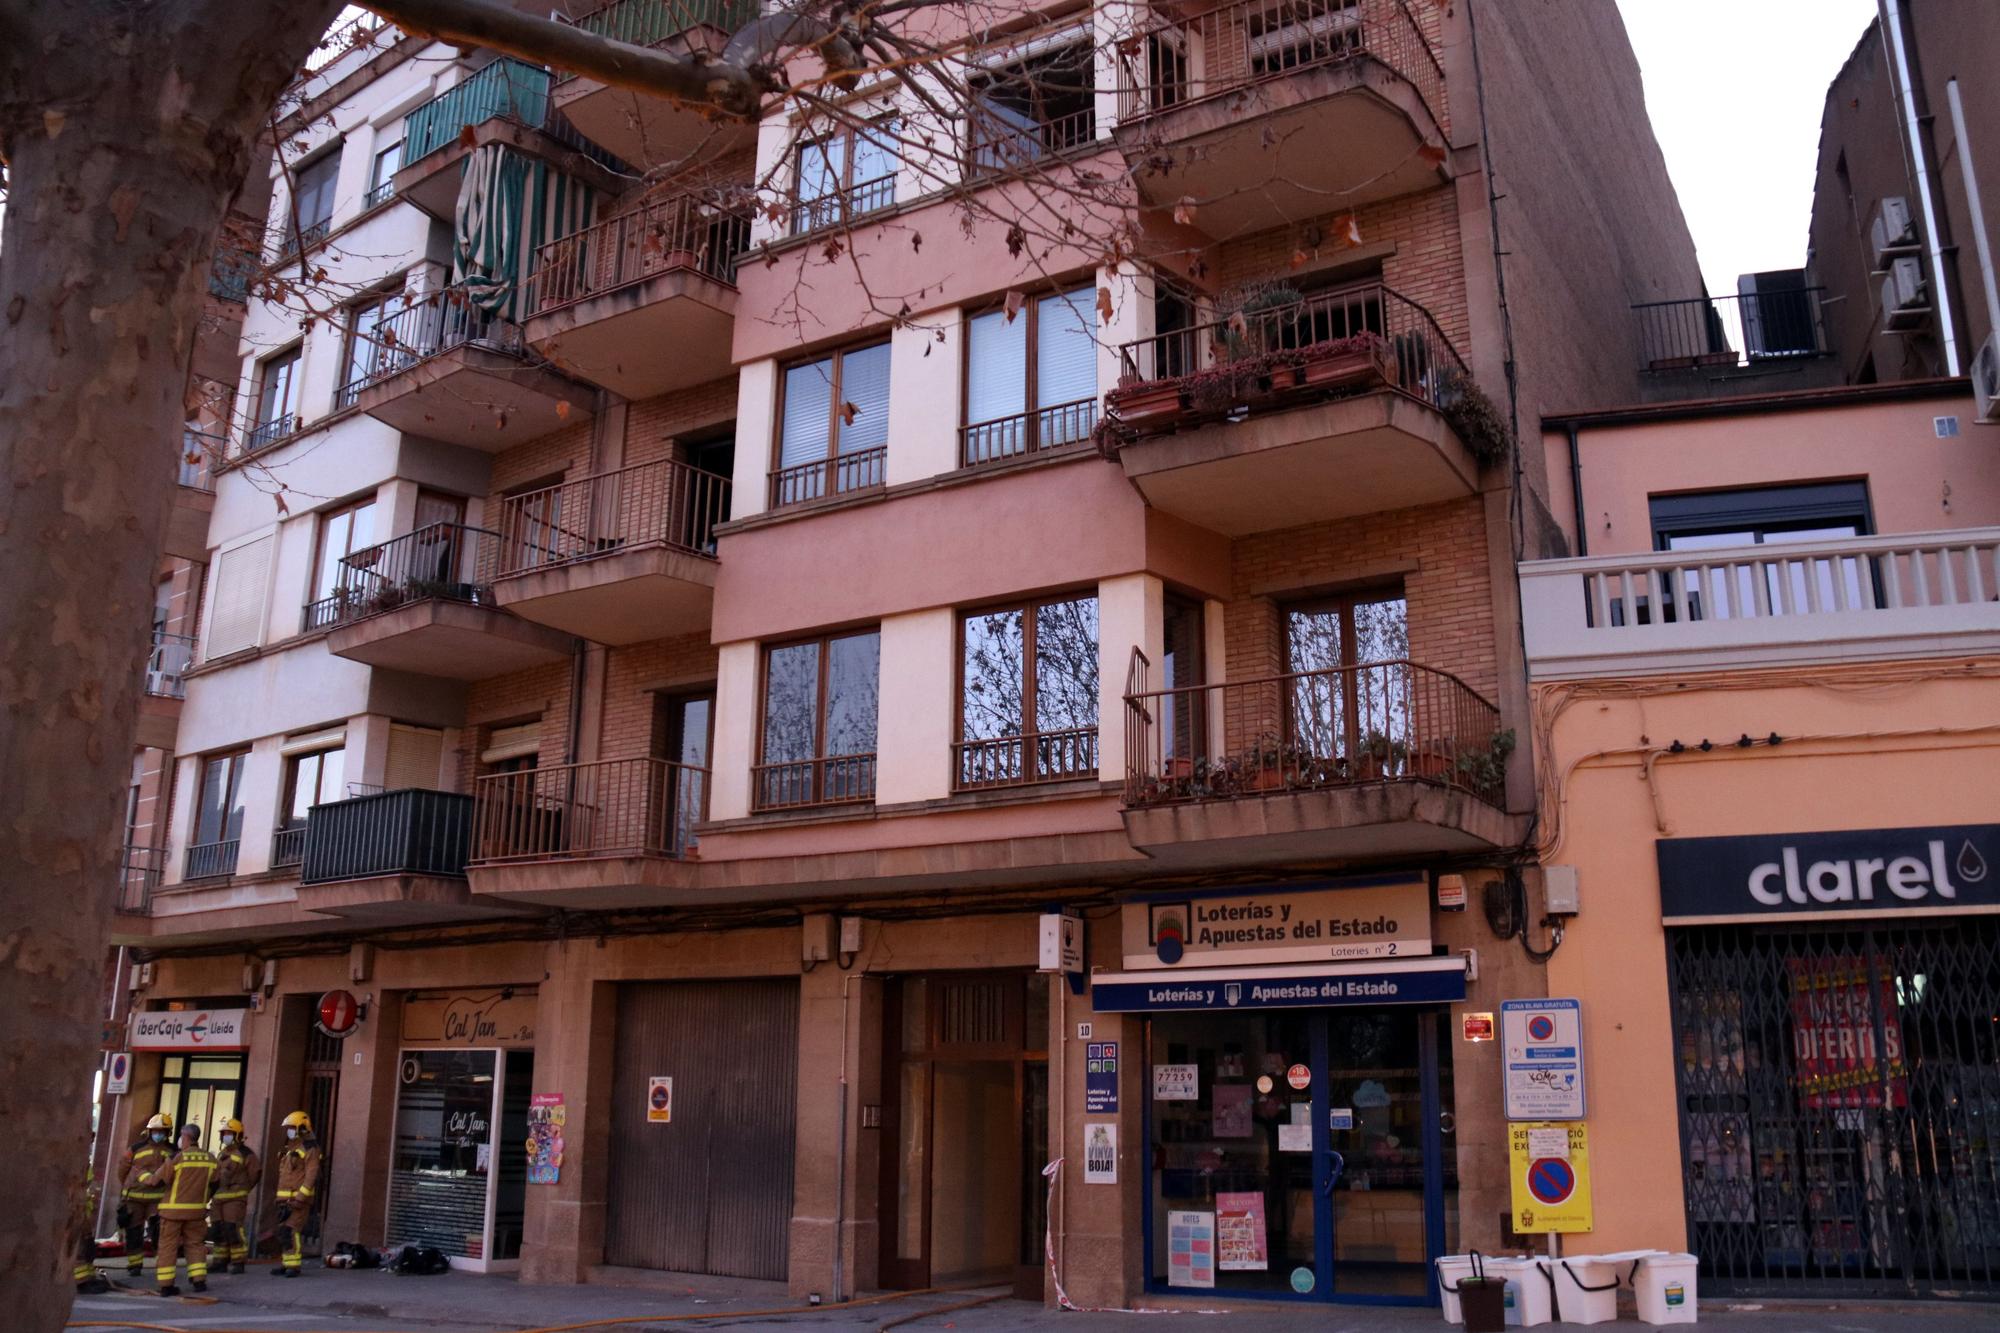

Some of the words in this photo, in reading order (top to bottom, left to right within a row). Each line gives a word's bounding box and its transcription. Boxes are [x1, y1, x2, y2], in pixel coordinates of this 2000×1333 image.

[1747, 839, 1955, 905] clarel
[1197, 901, 1273, 922] Loterías
[1280, 903, 1291, 922] y
[1199, 925, 1286, 948] Apuestas
[1293, 920, 1321, 939] del
[1329, 916, 1398, 937] Estado
[1331, 946, 1369, 957] Loteries
[1388, 943, 1397, 955] 2
[1149, 988, 1203, 1002] Loterías
[1206, 989, 1215, 1003] y
[1251, 984, 1318, 1001] Apuestas
[1320, 981, 1343, 996] del
[1346, 980, 1397, 995] Estado
[137, 1018, 182, 1040] iberCaja
[210, 1021, 234, 1034] Lleida
[445, 1012, 467, 1040] Cal
[470, 1011, 496, 1042] Jan
[1081, 1025, 1090, 1036] 10
[1158, 1073, 1193, 1082] 77259
[1109, 1095, 1117, 1103] del
[449, 1111, 466, 1132] Cal
[466, 1111, 485, 1135] Jan
[1088, 1160, 1113, 1172] BOJA!
